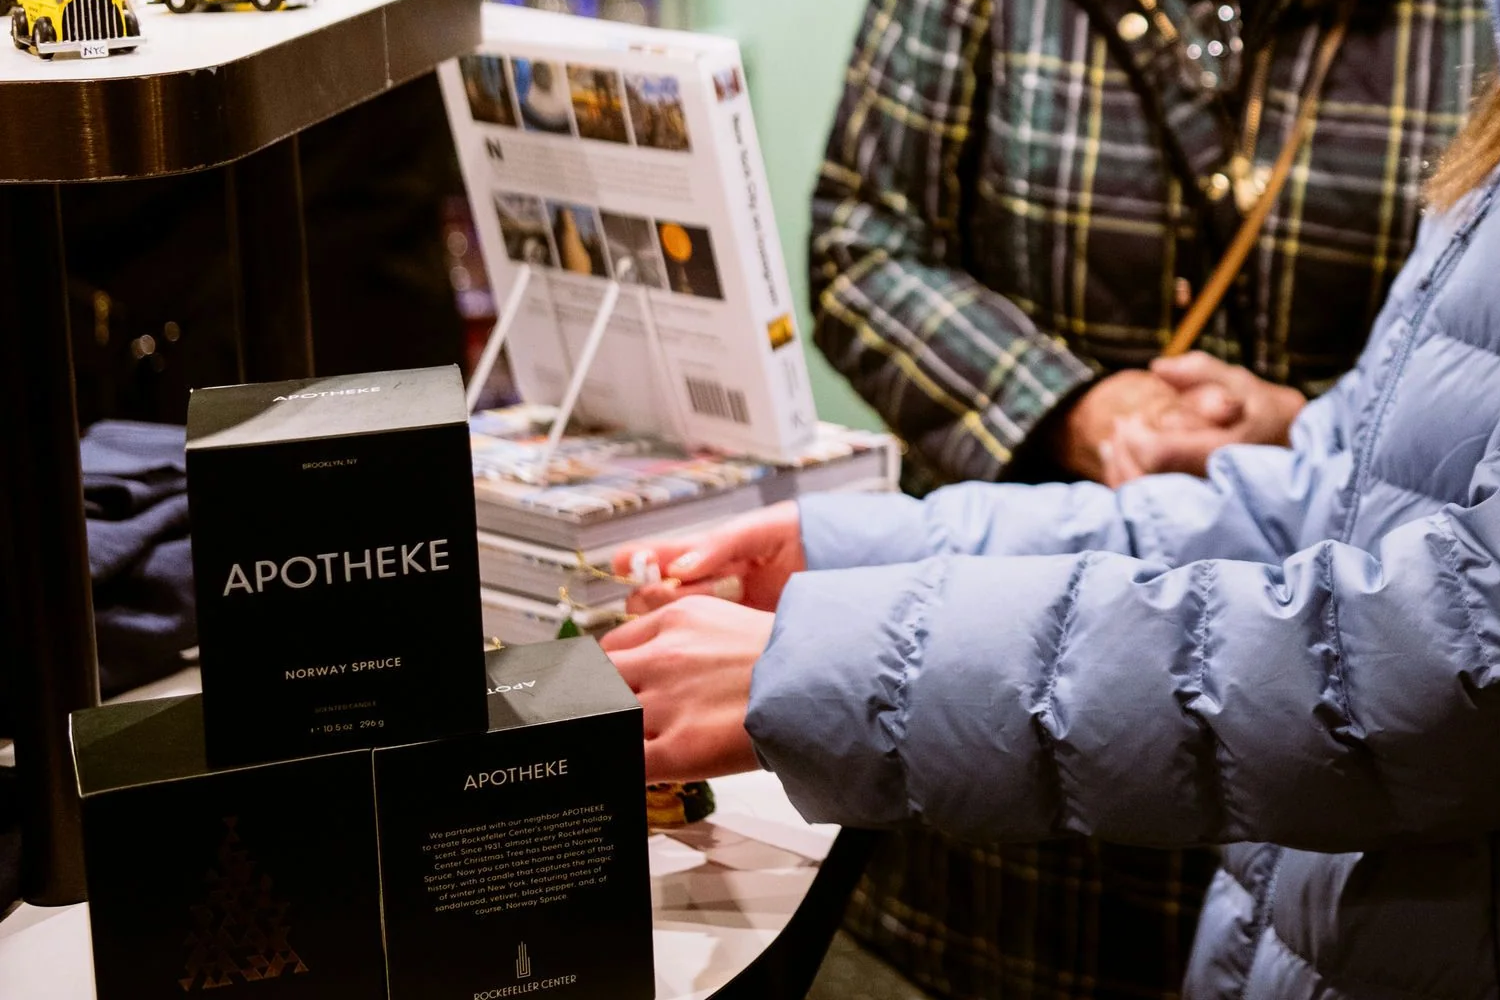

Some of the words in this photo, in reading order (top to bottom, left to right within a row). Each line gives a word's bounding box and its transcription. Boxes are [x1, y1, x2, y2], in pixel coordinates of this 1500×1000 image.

[83, 46, 106, 56] NYC
[273, 386, 381, 402] APOTHEKE
[346, 458, 358, 466] NY
[223, 538, 450, 597] APOTHEKE
[285, 663, 348, 681] NORWAY
[351, 656, 402, 673] SPRUCE
[486, 680, 536, 695] APOT
[464, 759, 568, 791] APOTHEKE
[433, 840, 459, 850] create
[462, 832, 506, 844] Rockefeller
[509, 826, 541, 837] Center's
[543, 820, 580, 831] signature
[583, 814, 612, 824] holiday
[446, 824, 486, 838] partnered
[489, 821, 506, 830] with
[524, 813, 560, 824] neighbor
[562, 804, 604, 816] APOTHEKE
[434, 861, 461, 870] Center
[464, 854, 504, 865] Christmas
[543, 843, 562, 851] been
[572, 837, 604, 846] Norway
[461, 847, 482, 855] Since
[505, 838, 532, 847] almost
[558, 827, 602, 838] Rockefeller
[457, 868, 476, 876] Now
[512, 859, 529, 867] take
[532, 854, 554, 863] home
[564, 850, 585, 859] piece
[598, 844, 614, 853] that
[460, 879, 477, 887] with
[487, 872, 515, 882] candle
[517, 868, 534, 877] that
[536, 863, 570, 874] captures
[587, 855, 611, 864] magic
[450, 890, 475, 898] winter
[531, 873, 567, 884] featuring
[570, 869, 591, 877] notes
[521, 888, 543, 897] black
[598, 875, 607, 883] of
[506, 899, 538, 909] Norway
[473, 981, 539, 1000] ROCKEFELLER
[541, 974, 577, 989] CENTER
